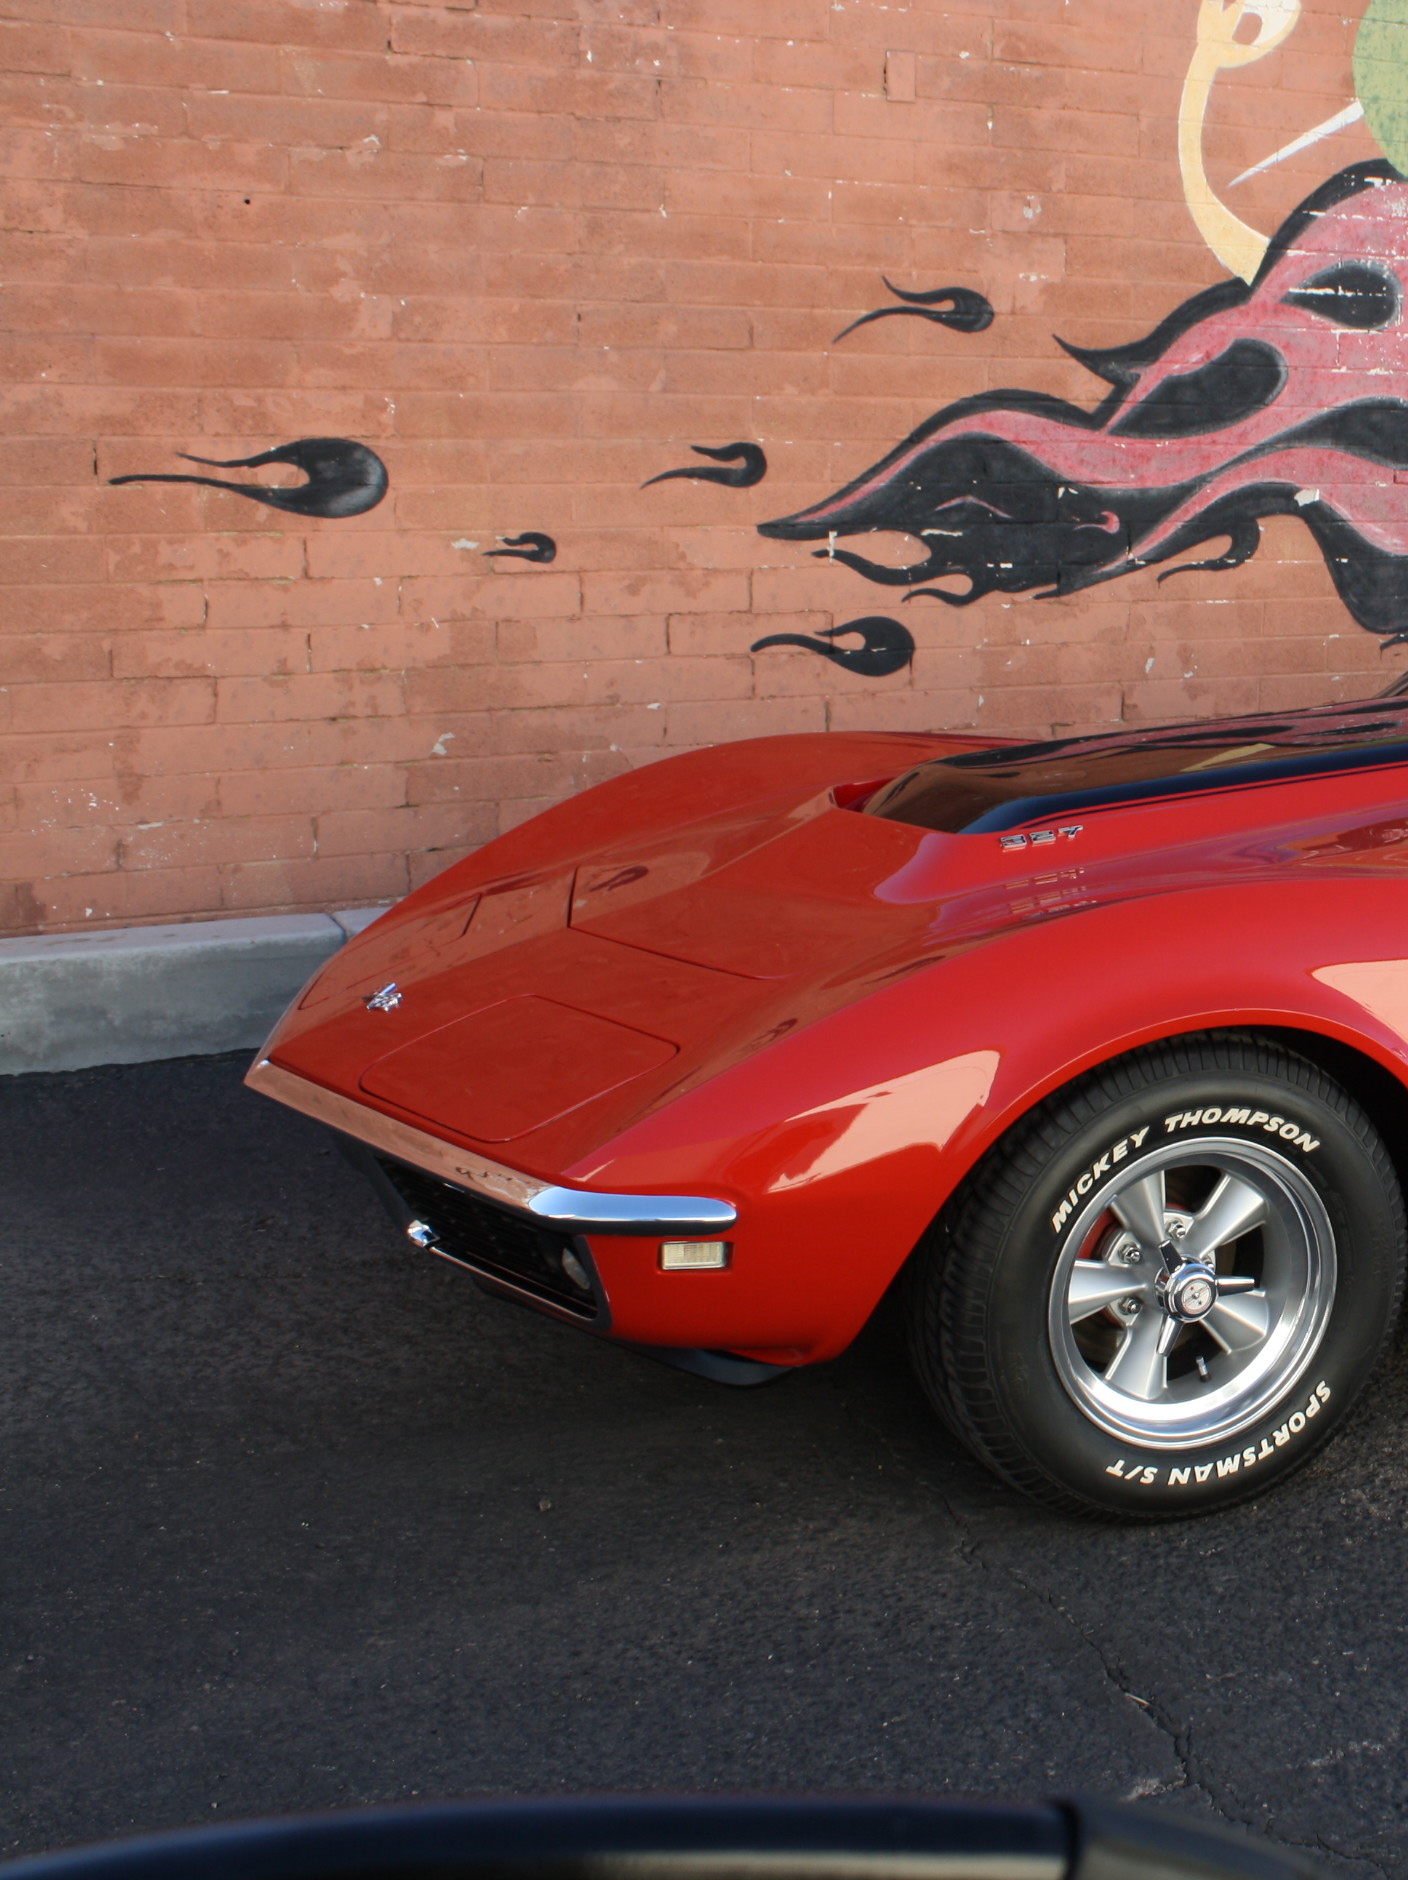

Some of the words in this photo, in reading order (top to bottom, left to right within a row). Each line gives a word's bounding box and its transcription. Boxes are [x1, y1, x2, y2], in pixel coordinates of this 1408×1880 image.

[1051, 1126, 1150, 1234] MICKEY
[1164, 1107, 1321, 1153] THOMPSON
[1105, 1459, 1158, 1485] S/T
[1167, 1380, 1332, 1486] SPORTSMAN
